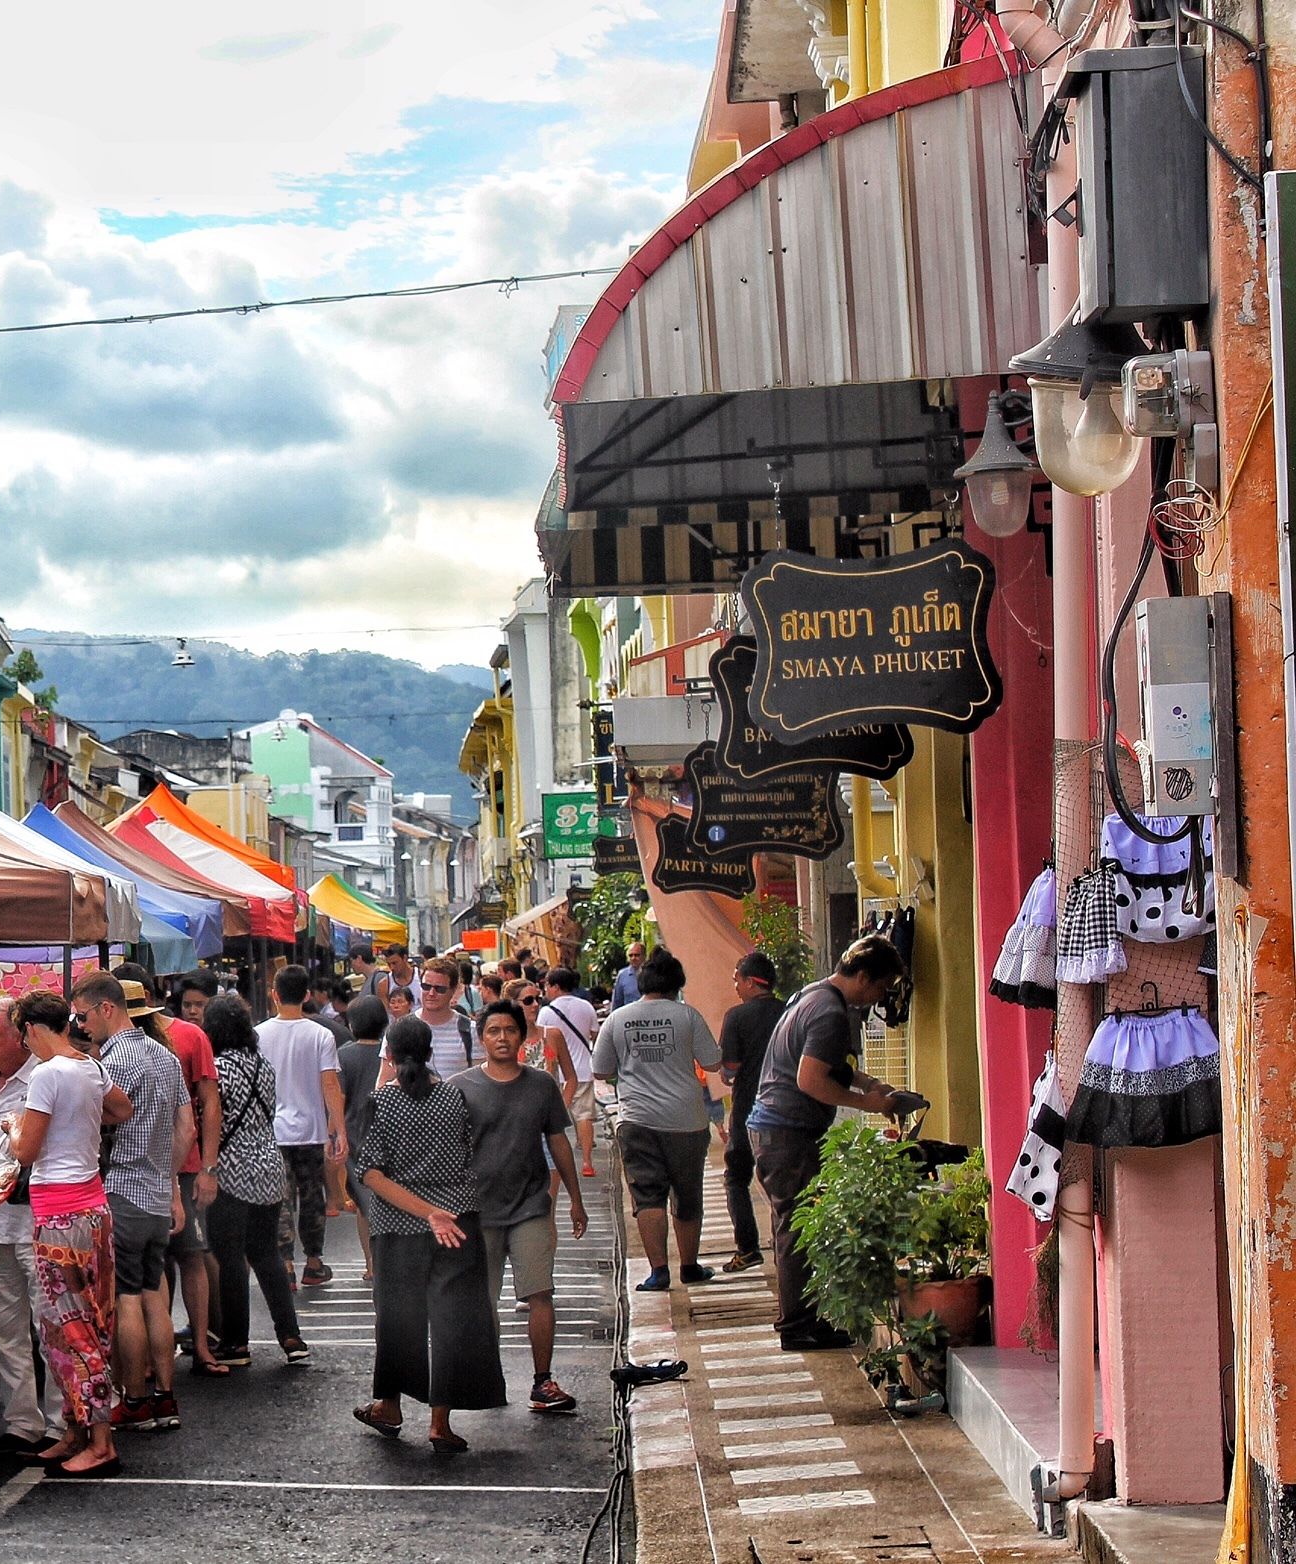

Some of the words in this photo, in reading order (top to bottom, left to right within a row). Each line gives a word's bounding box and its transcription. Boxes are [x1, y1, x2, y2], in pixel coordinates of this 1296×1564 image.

[780, 607, 873, 641] สมายา
[889, 588, 961, 647] ภูเก็ต
[782, 656, 865, 679] SMAYA
[874, 649, 965, 674] PHUKET
[705, 813, 733, 821] TOURIST
[735, 813, 783, 821] INFORMATION
[785, 812, 812, 820] CENTER
[664, 858, 705, 873] PARTY
[711, 862, 746, 876] SHOP
[624, 1019, 651, 1028] ONLY
[665, 1018, 672, 1026] A
[632, 1031, 667, 1044] Jeep
